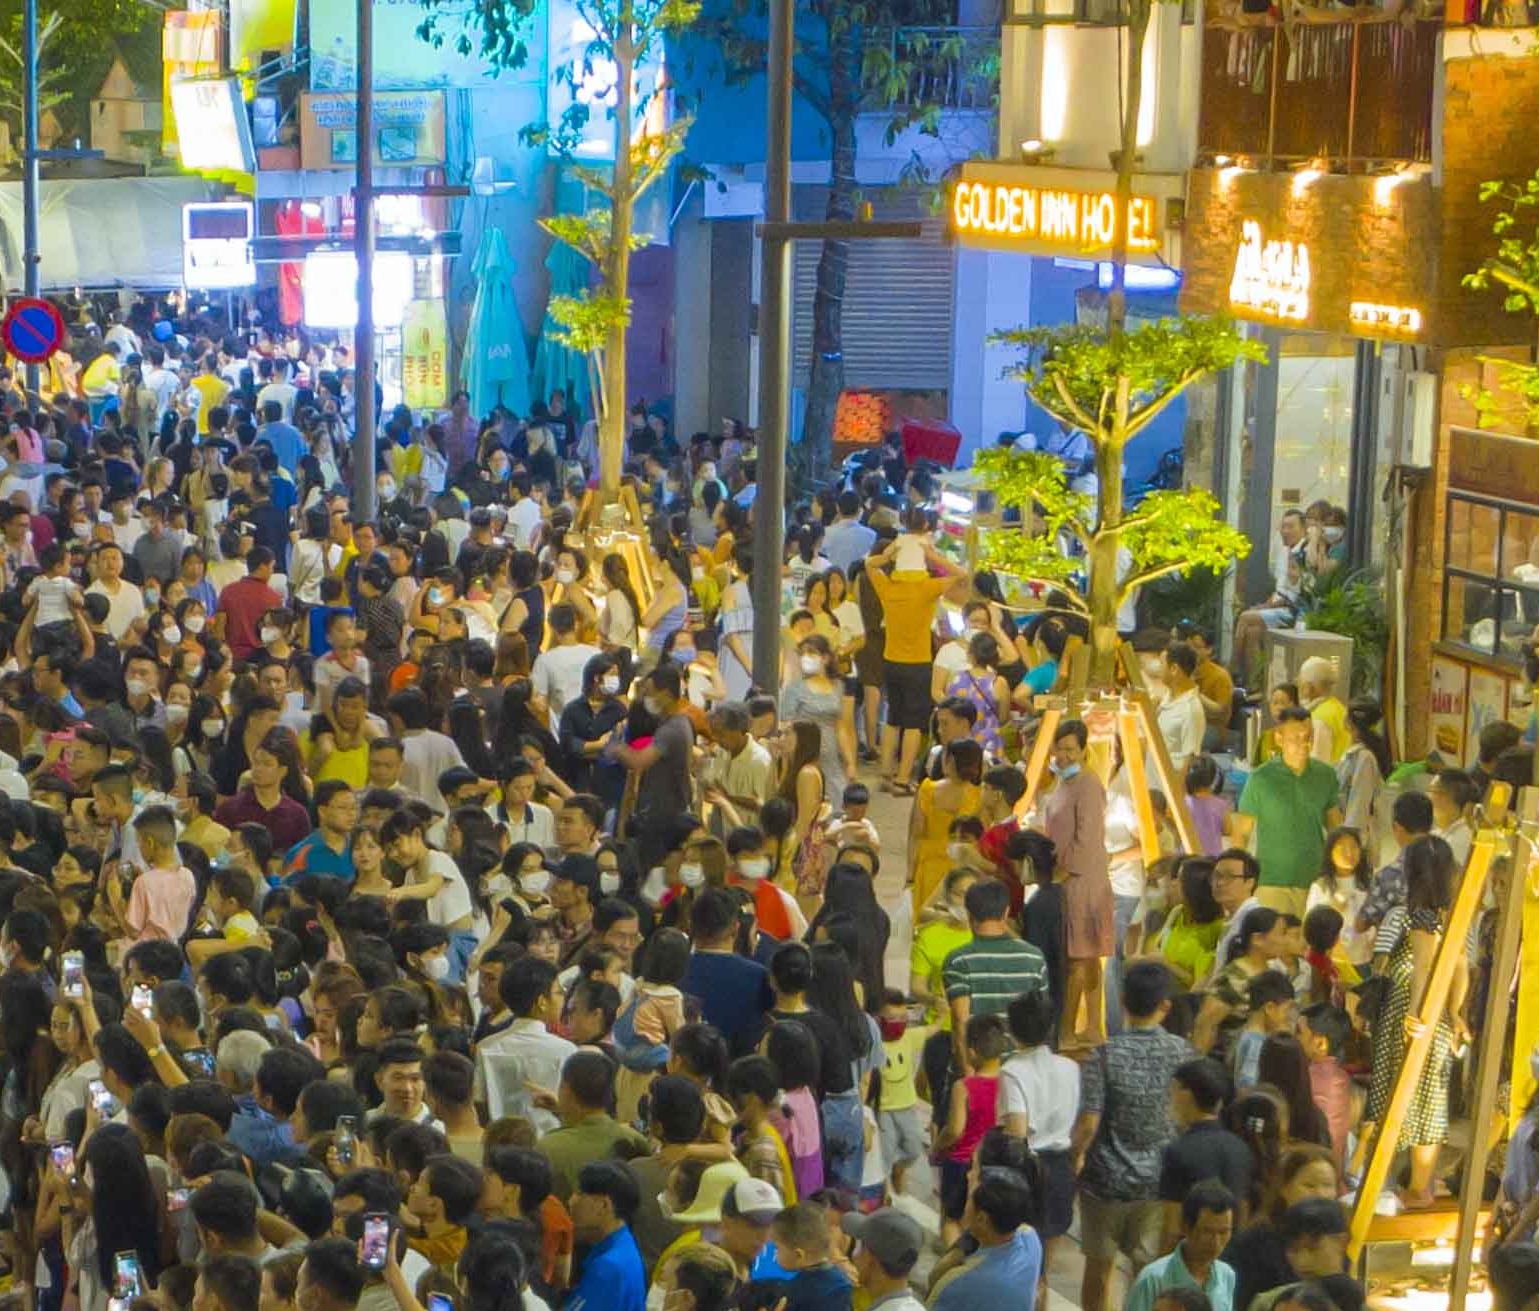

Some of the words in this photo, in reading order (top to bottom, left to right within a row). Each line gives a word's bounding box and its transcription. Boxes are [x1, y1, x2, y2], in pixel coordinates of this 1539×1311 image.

[954, 181, 1036, 232] GOLDEN
[1039, 191, 1077, 237] INN
[1080, 192, 1159, 247] HOEL
